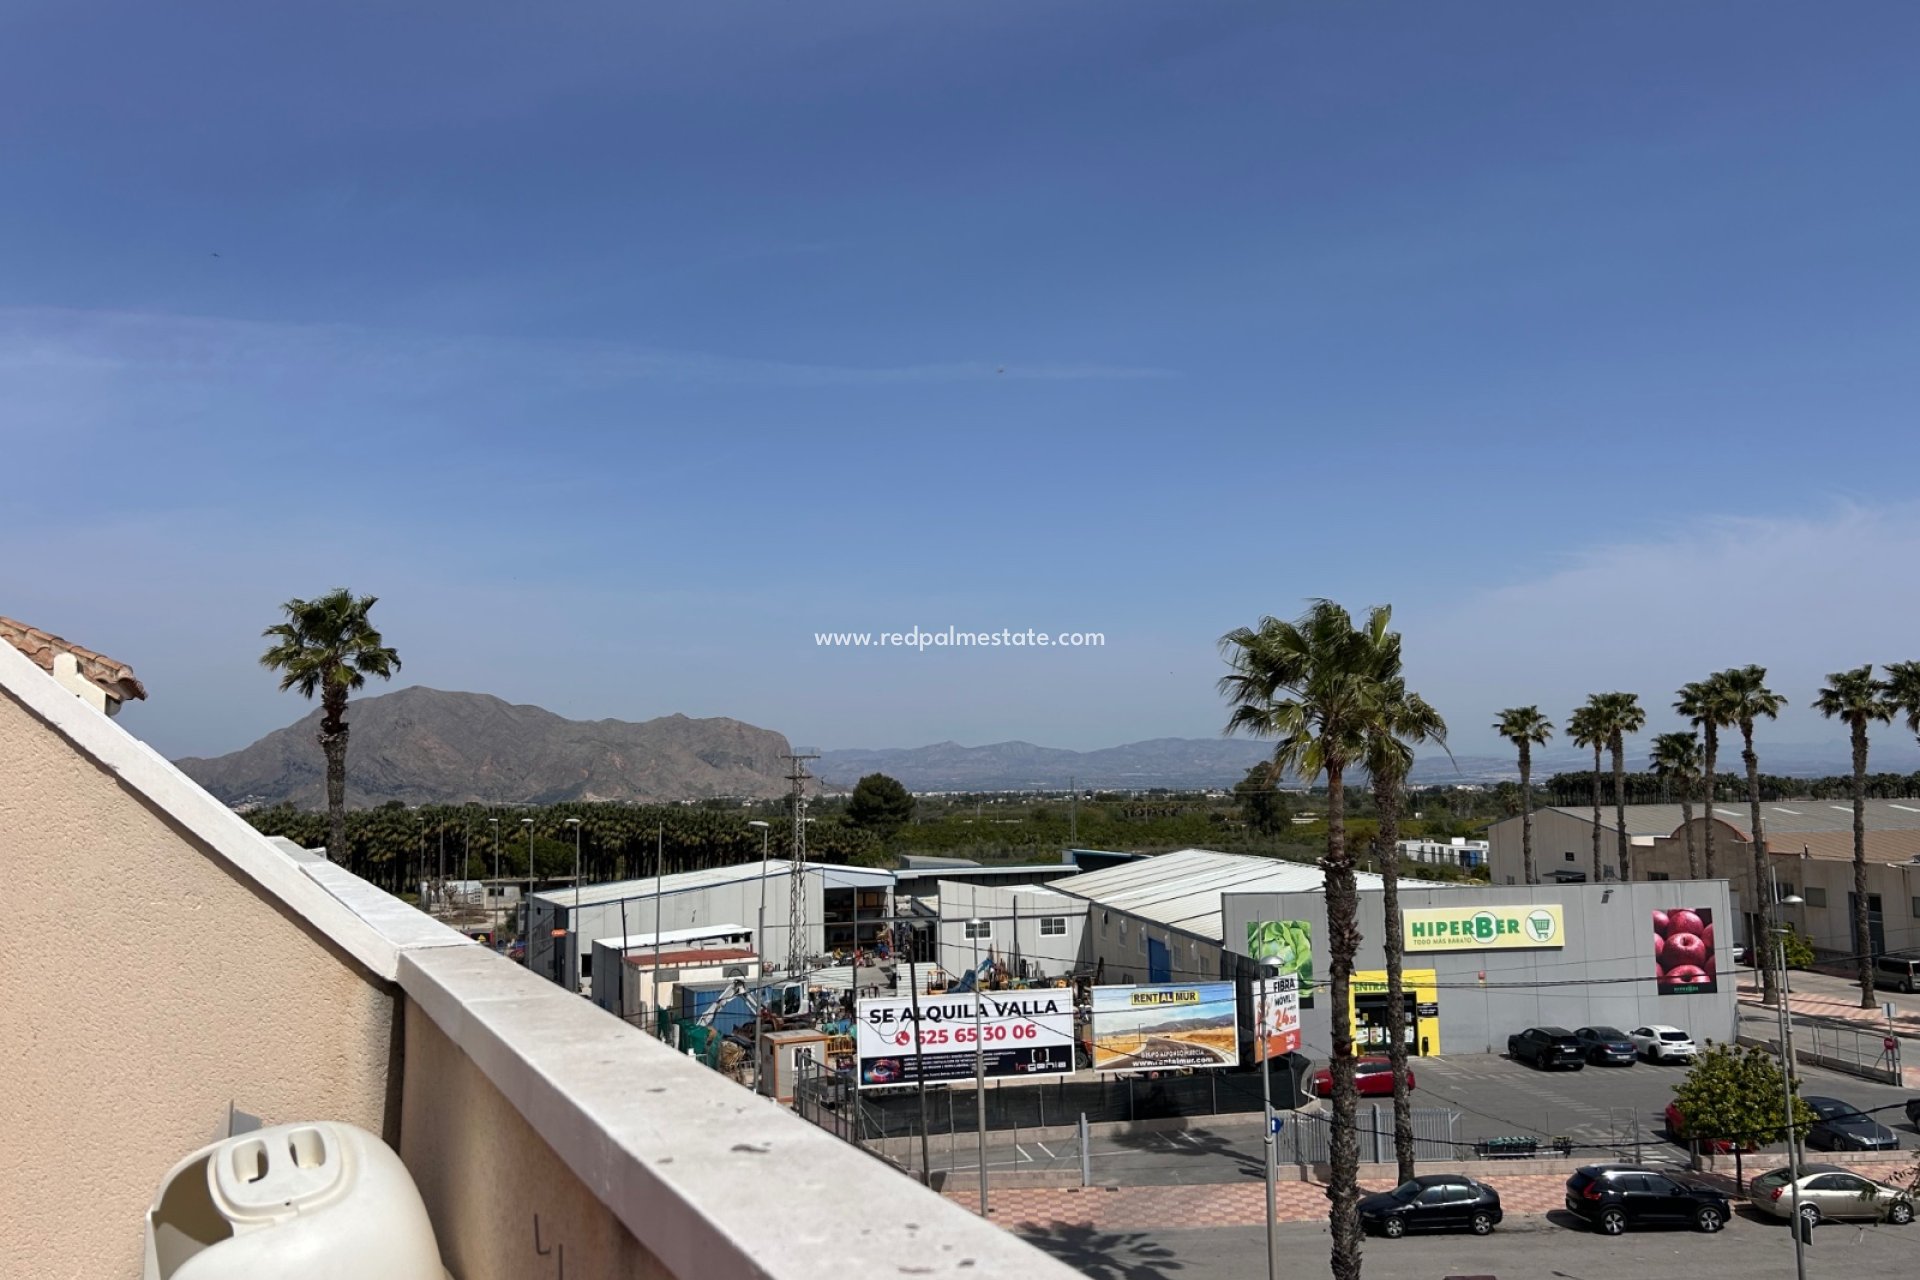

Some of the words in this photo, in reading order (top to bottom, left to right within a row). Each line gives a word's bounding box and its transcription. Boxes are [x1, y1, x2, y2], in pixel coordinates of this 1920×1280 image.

[1273, 978, 1295, 993] FIBRA
[869, 1008, 895, 1024] SE
[900, 1004, 989, 1023] ALQUILA
[995, 999, 1058, 1017] VALLA
[954, 1027, 978, 1043] 65
[983, 1026, 1007, 1042] 30
[1012, 1024, 1037, 1039] 06
[1132, 1056, 1214, 1067] www.rentalmur.com
